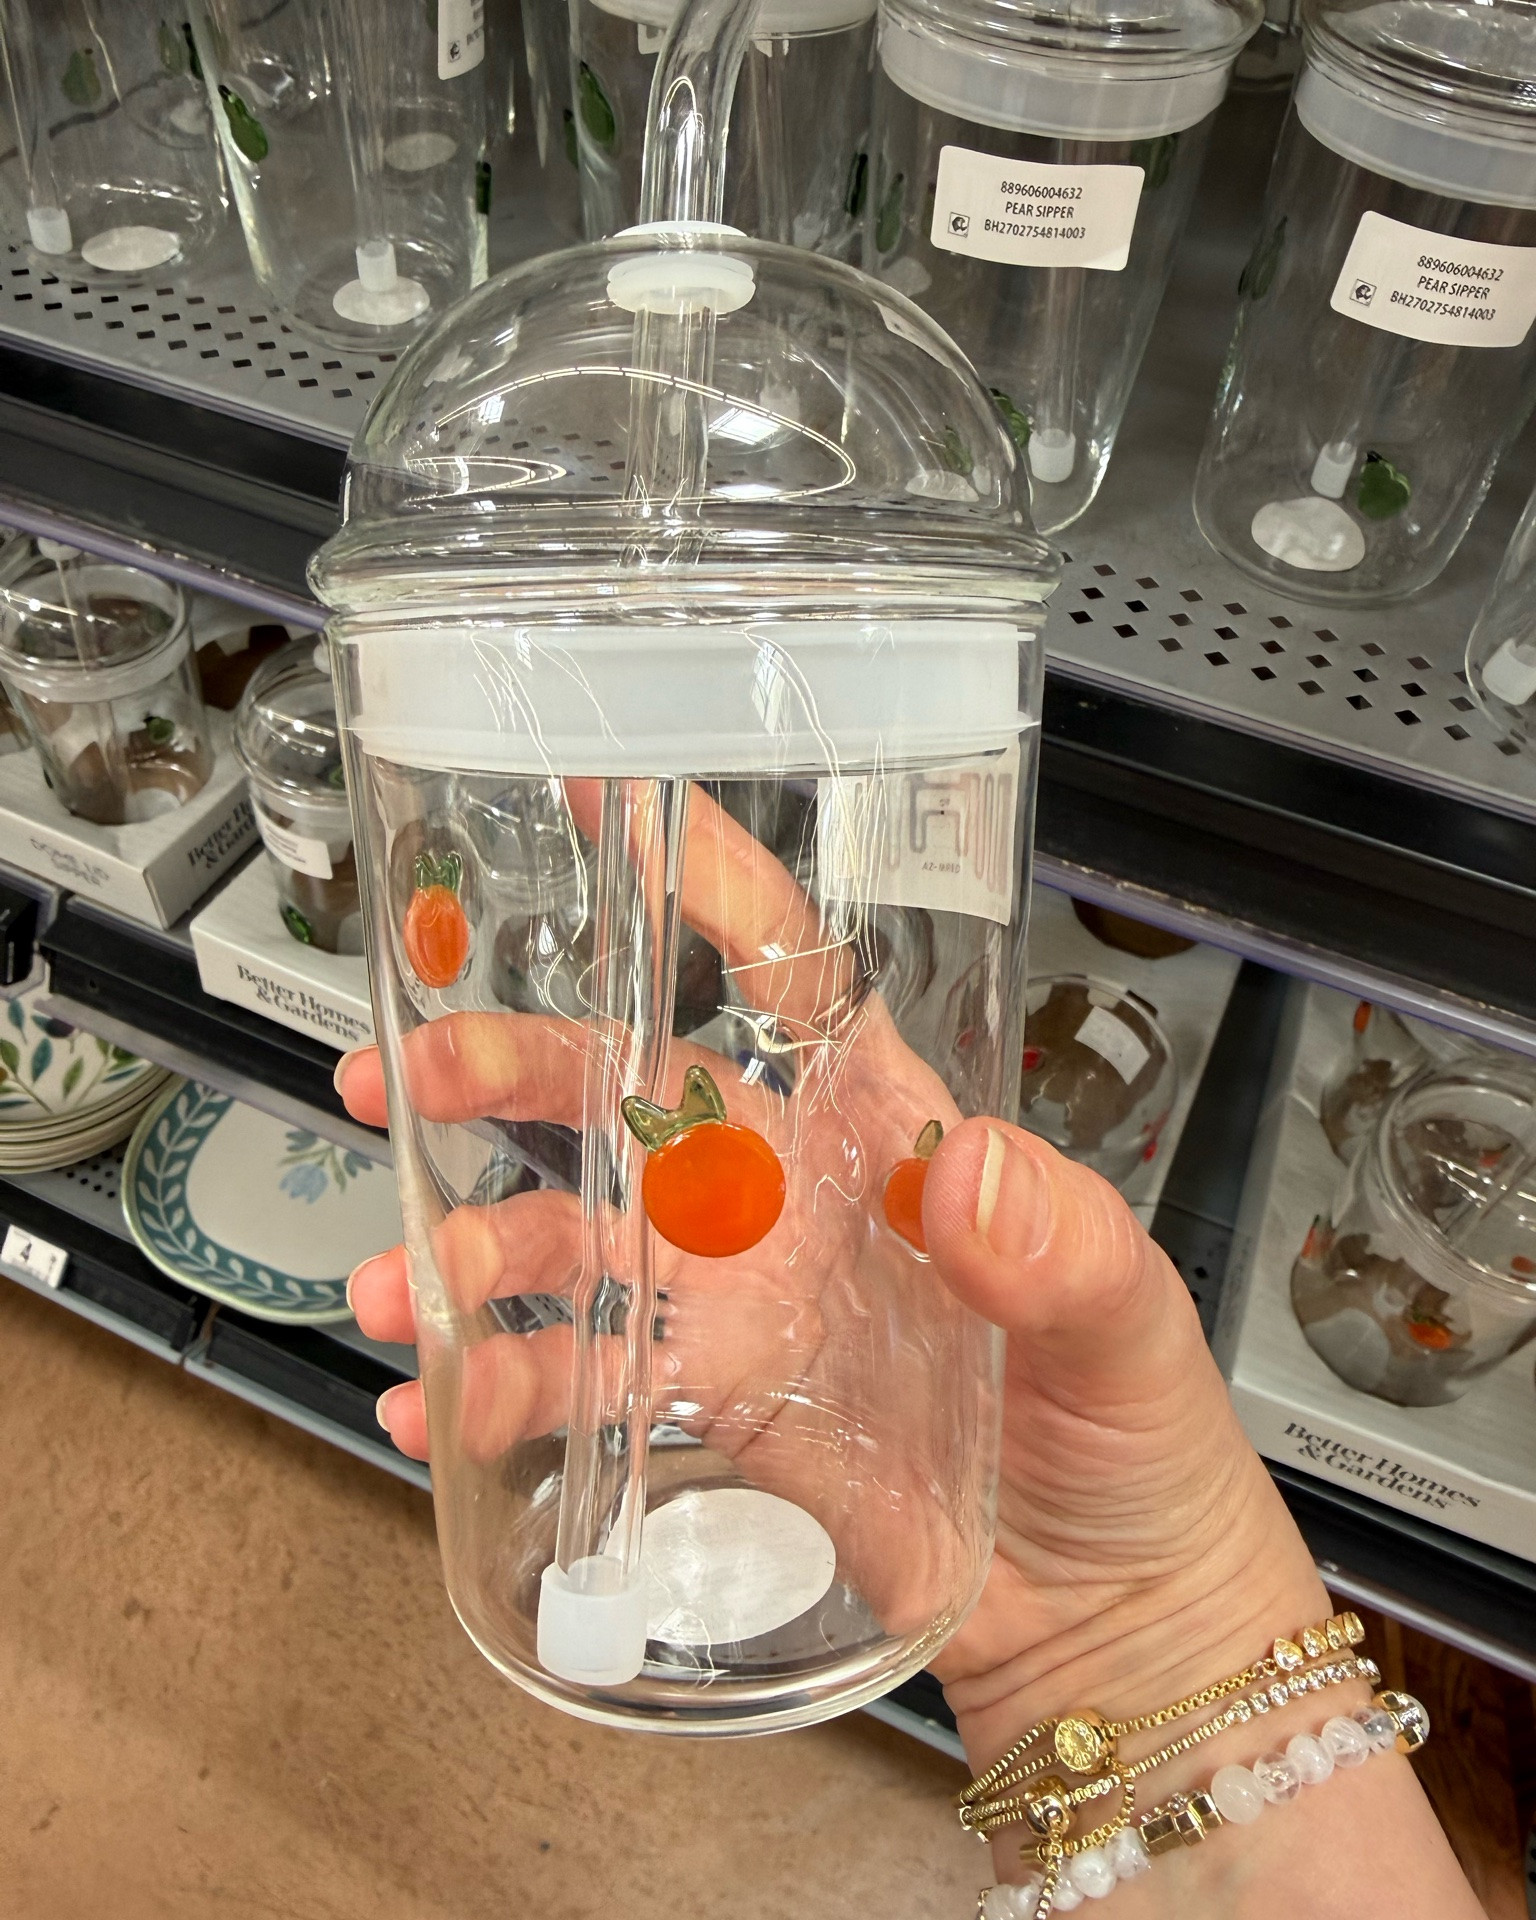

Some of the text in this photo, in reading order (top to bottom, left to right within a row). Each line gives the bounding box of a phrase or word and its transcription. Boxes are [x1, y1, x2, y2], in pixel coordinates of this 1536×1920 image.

[1000, 181, 1083, 200] 889606004632
[1005, 201, 1075, 219] PEAR SIPPER
[984, 219, 1086, 239] BH2702754814003
[1417, 255, 1504, 282] 889606004632
[1417, 275, 1491, 300] PEAR SIPPER
[237, 964, 372, 1036] Better Homes
[273, 994, 360, 1042] Gardens
[1283, 1421, 1482, 1508] Better Homes
[1296, 1443, 1453, 1510] & Gardens
